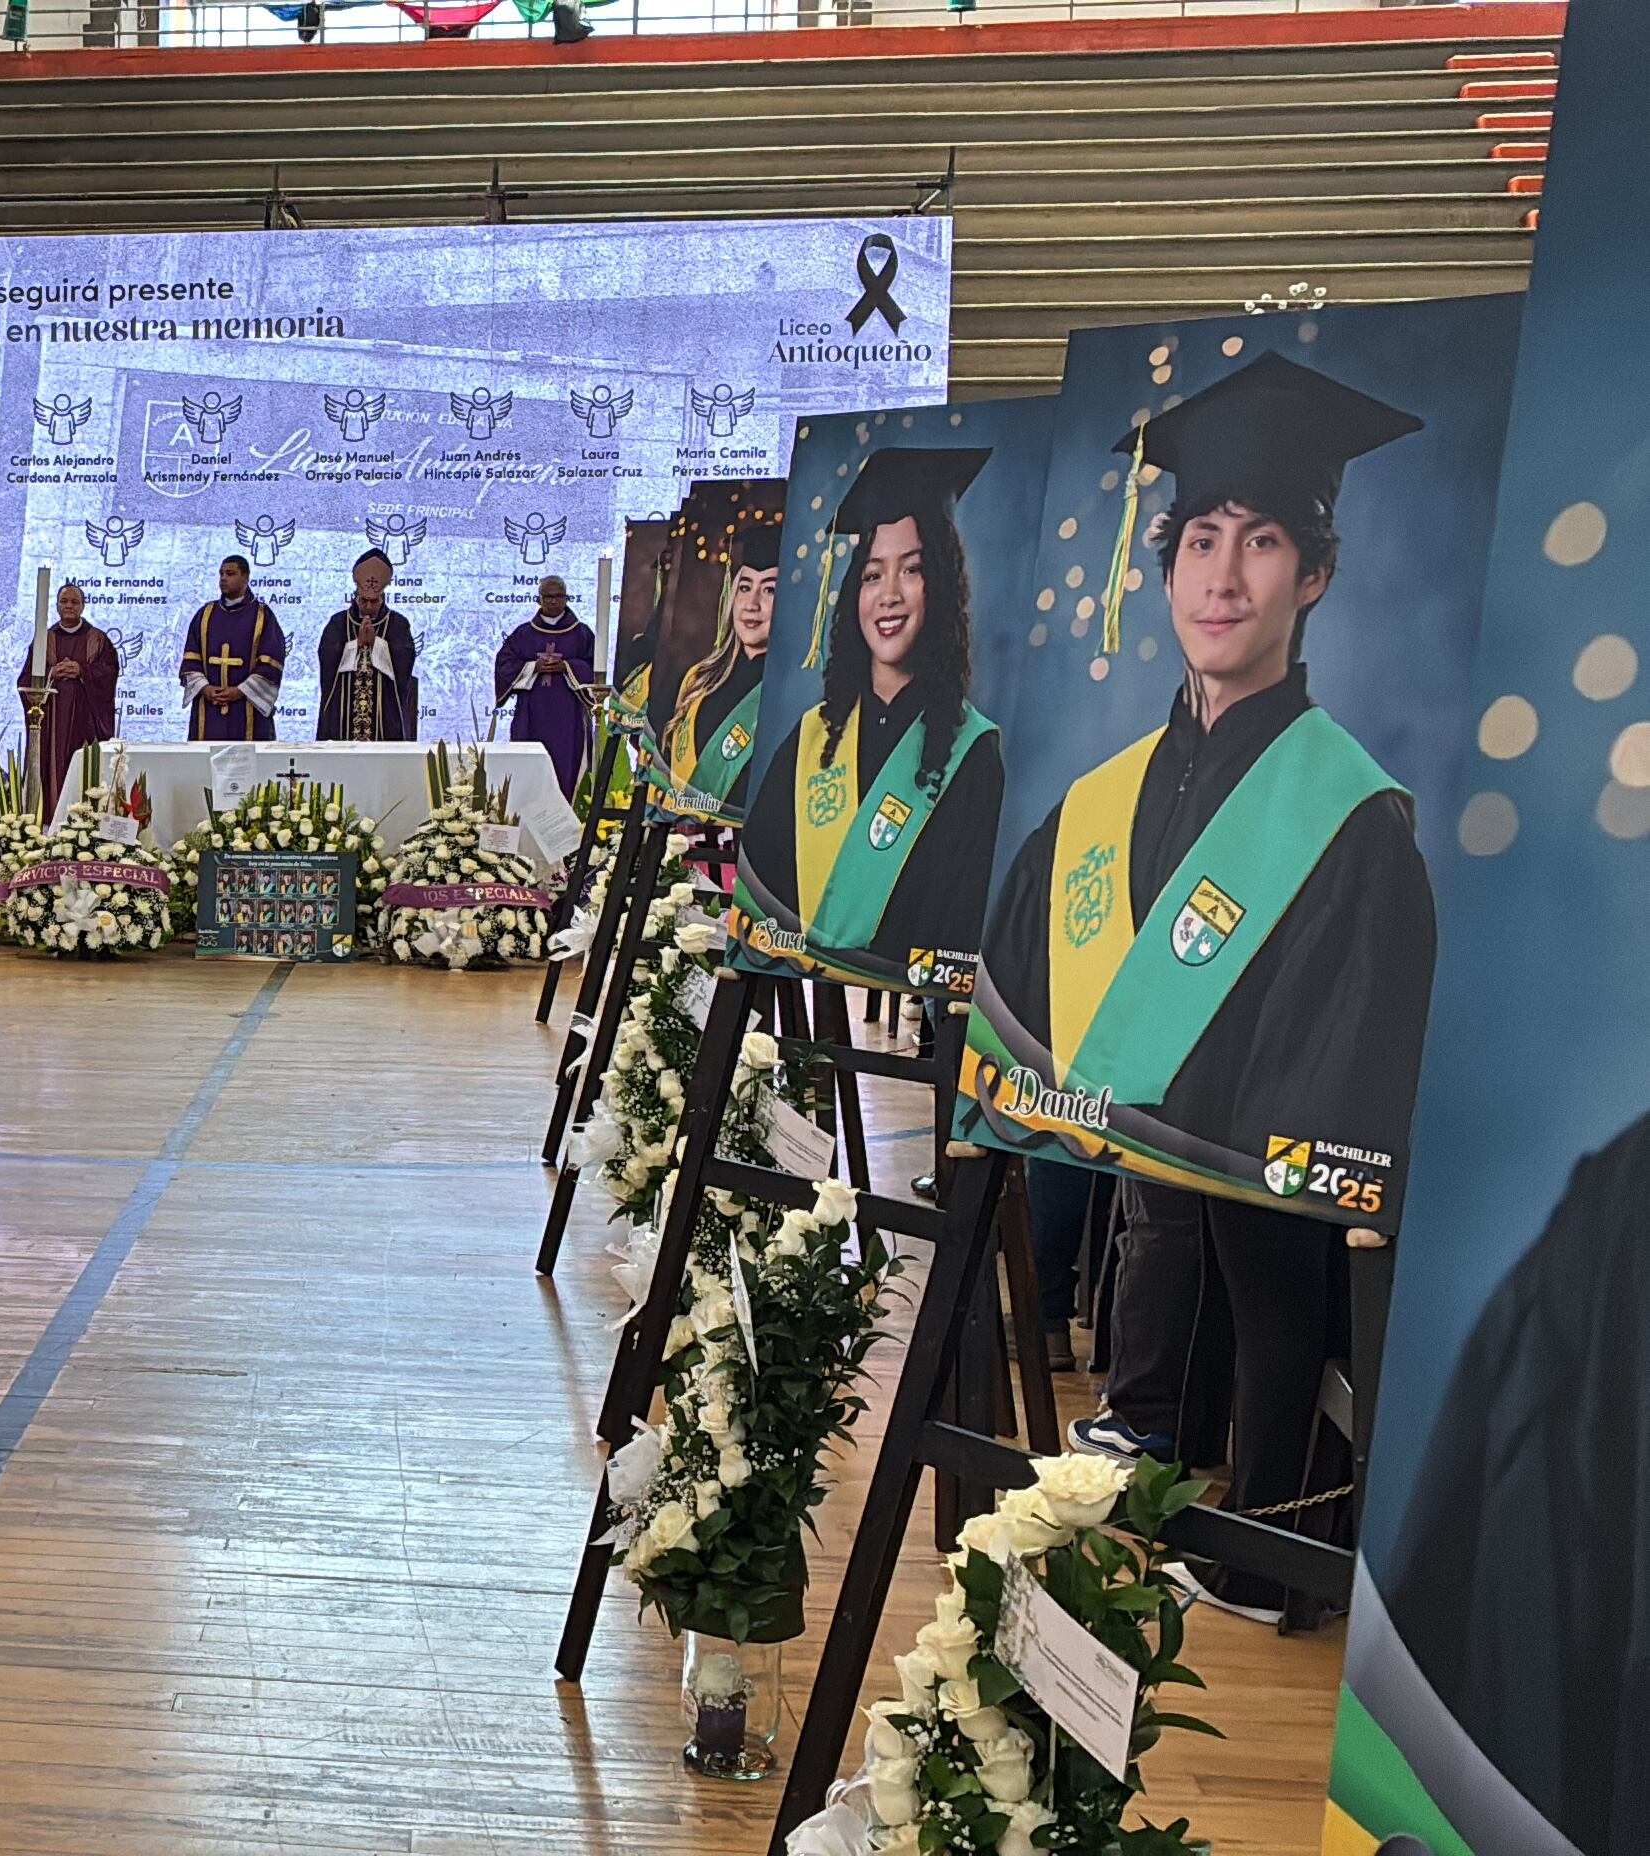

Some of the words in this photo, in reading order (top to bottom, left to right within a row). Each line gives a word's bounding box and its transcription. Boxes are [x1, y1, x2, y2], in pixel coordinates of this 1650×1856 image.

[108, 278, 234, 309] presente
[6, 324, 42, 343] en
[49, 317, 178, 343] nuestra
[191, 306, 345, 340] memoria
[779, 318, 832, 336] Liceo
[768, 338, 933, 369] Antioqueño
[10, 454, 50, 467] Carlos
[53, 453, 115, 469] Alejandro
[191, 452, 232, 465] Daniel
[313, 450, 344, 466] José
[346, 450, 395, 464] Manuel
[439, 450, 470, 463] Juan
[474, 448, 521, 463] Andrés
[580, 448, 620, 461] Laura
[676, 447, 716, 460] María
[720, 446, 767, 460] Camila
[6, 471, 50, 484] Cardona
[53, 470, 118, 484] Arrazola
[144, 470, 210, 486] Arismendy
[213, 468, 280, 484] Fernández
[305, 470, 351, 485] Orrego
[355, 468, 403, 481] Palacio
[424, 466, 482, 483] Hincapié
[485, 466, 537, 480] Salazar
[557, 466, 605, 480] Salazar
[608, 464, 643, 479] Cruz
[672, 464, 708, 478] Pérez
[711, 462, 771, 478] Sánchez
[64, 575, 101, 588] María
[105, 577, 165, 588] Fernanda
[249, 577, 292, 588] ariana
[117, 593, 168, 606] Jiménez
[271, 593, 302, 605] Arias
[394, 593, 447, 604] Escobar
[126, 704, 164, 716] Builes
[14, 865, 78, 884] ERVICIOS
[82, 864, 160, 885] ESPECIAL
[756, 918, 807, 952] Sara
[936, 948, 980, 963] BACHILLER
[932, 963, 975, 994] 2025
[1003, 1066, 1113, 1130] Daniel
[1314, 1140, 1392, 1168] BACHILLER
[1308, 1162, 1384, 1214] 2025
